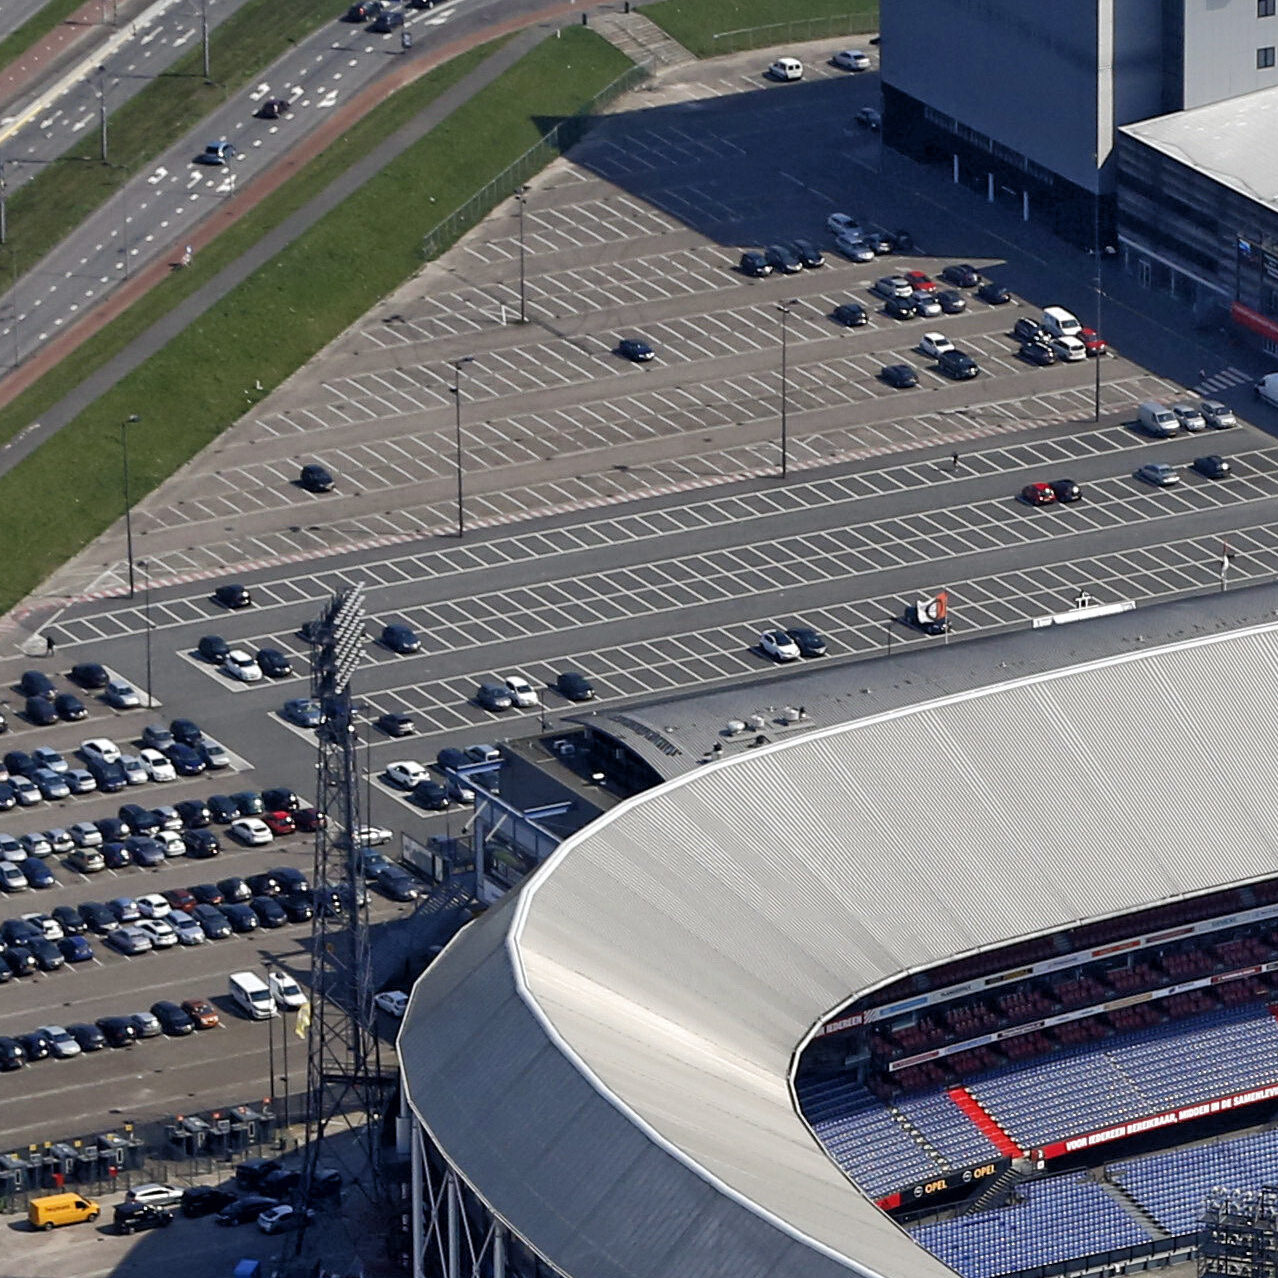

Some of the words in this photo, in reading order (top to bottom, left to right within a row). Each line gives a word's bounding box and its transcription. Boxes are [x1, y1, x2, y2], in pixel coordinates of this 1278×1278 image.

[1066, 1137, 1087, 1151] VOOR
[1088, 1126, 1126, 1145] IEDEREEN
[1127, 1113, 1178, 1134] BEREIKBAAR,
[1179, 1104, 1210, 1120] MIDDEN
[1211, 1101, 1220, 1112] IN
[1221, 1098, 1232, 1109] DE
[974, 1164, 996, 1179] OPEL
[925, 1179, 947, 1194] OPEL
